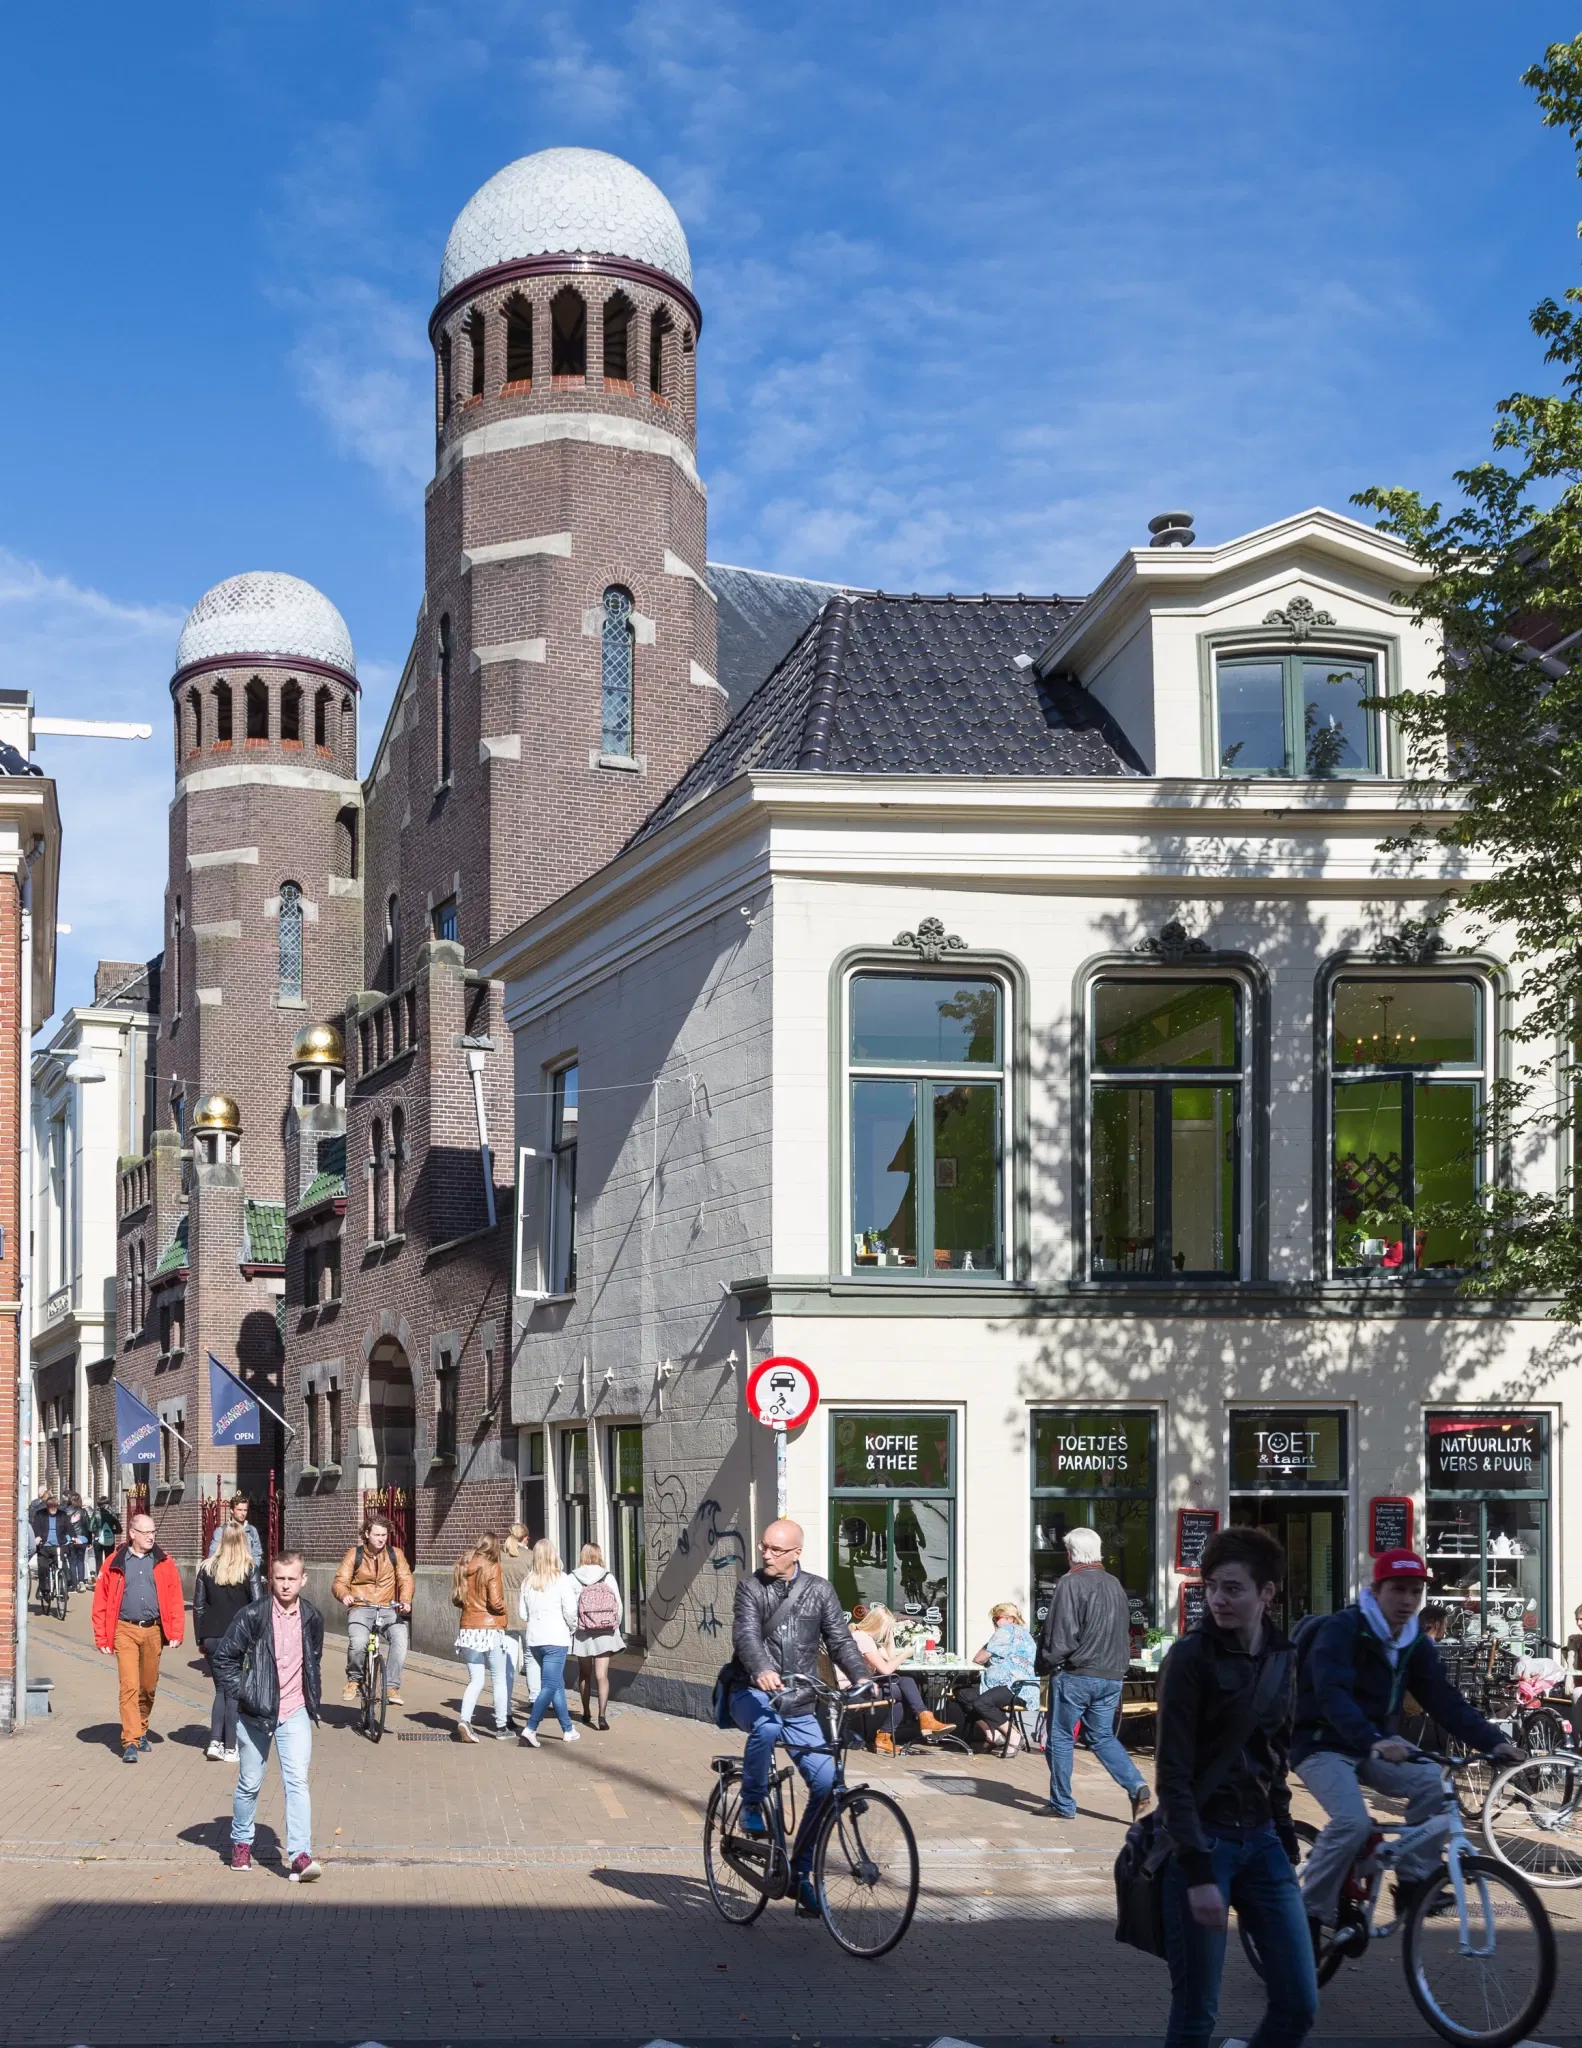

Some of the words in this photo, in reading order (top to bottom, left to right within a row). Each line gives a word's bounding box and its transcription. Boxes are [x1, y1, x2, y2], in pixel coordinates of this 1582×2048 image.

[215, 1399, 250, 1429] SYNAGOGE
[218, 1401, 256, 1435] GRONINGEN
[234, 1433, 255, 1441] OPEN
[865, 1435, 919, 1451] KOFFIE
[1057, 1435, 1128, 1451] TOETJES
[1253, 1431, 1320, 1453] TOET
[1440, 1437, 1532, 1452] NATUURLIJK
[1058, 1455, 1128, 1470] PARADIJS
[1259, 1454, 1269, 1464] &
[1273, 1454, 1315, 1464] taart
[1439, 1456, 1478, 1471] VERS
